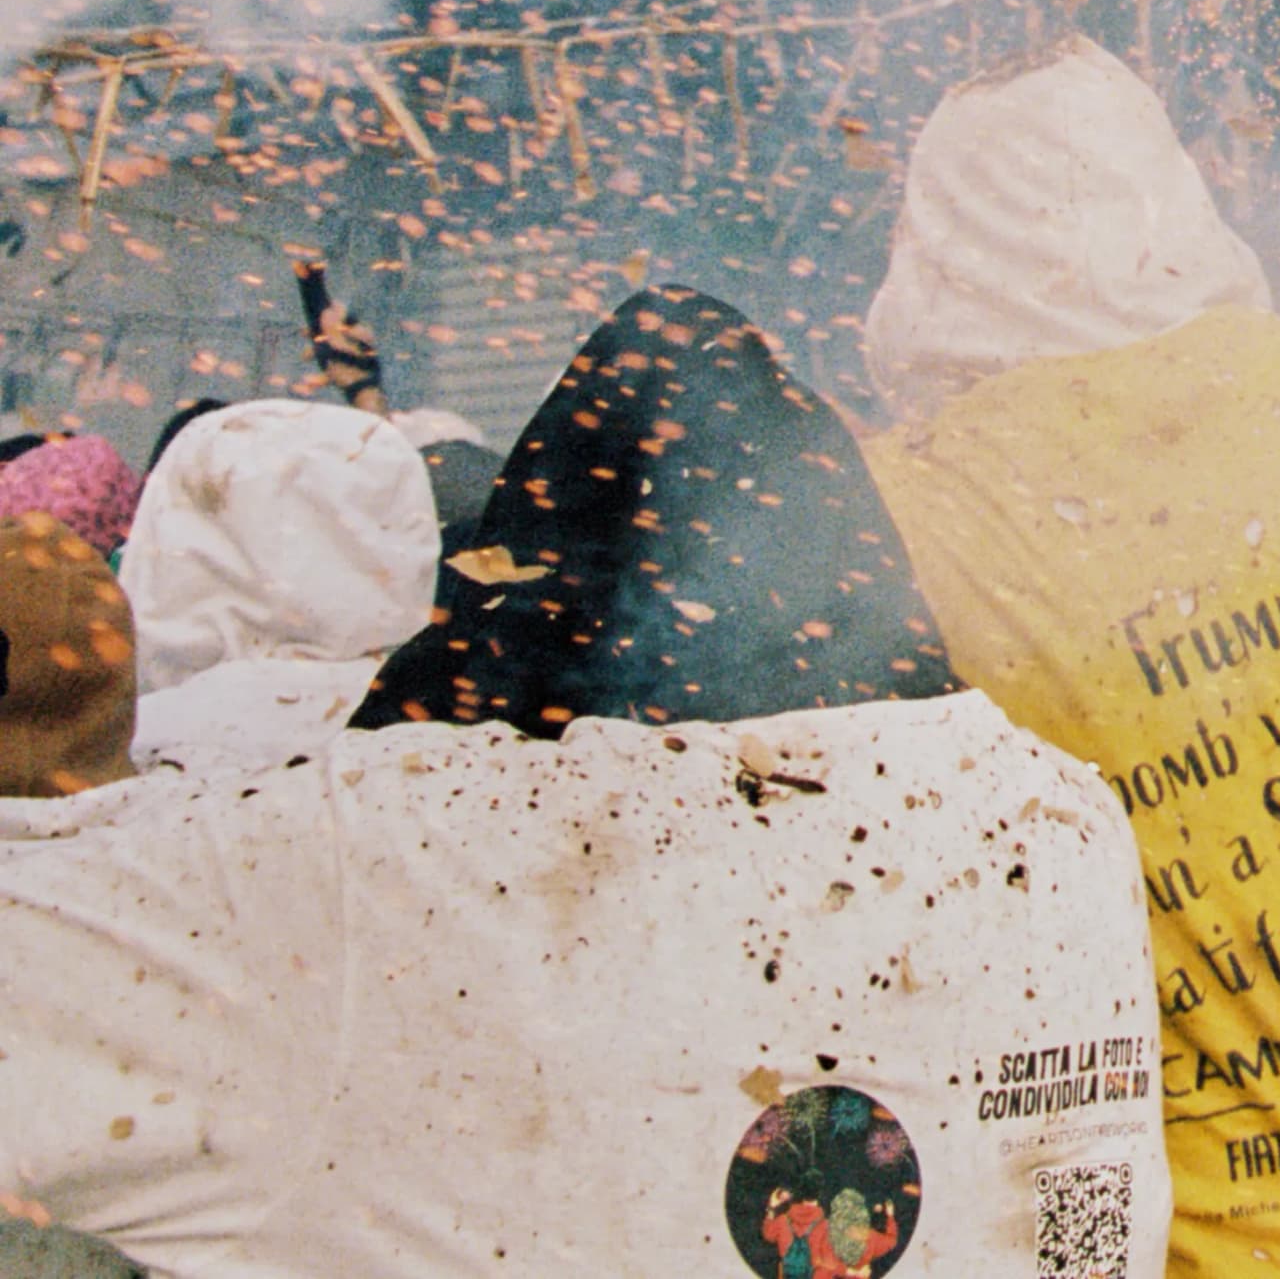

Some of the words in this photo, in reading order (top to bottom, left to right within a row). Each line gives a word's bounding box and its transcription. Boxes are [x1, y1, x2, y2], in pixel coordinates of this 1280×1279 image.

[1225, 835, 1270, 883] a
[1197, 923, 1257, 996] ti
[999, 1045, 1070, 1085] SCATTA
[1078, 1041, 1097, 1072] LA
[1102, 1037, 1133, 1068] FOTO
[1136, 1036, 1143, 1066] E
[978, 1073, 1098, 1122] CONDIVIDILA
[1104, 1071, 1128, 1102] CON
